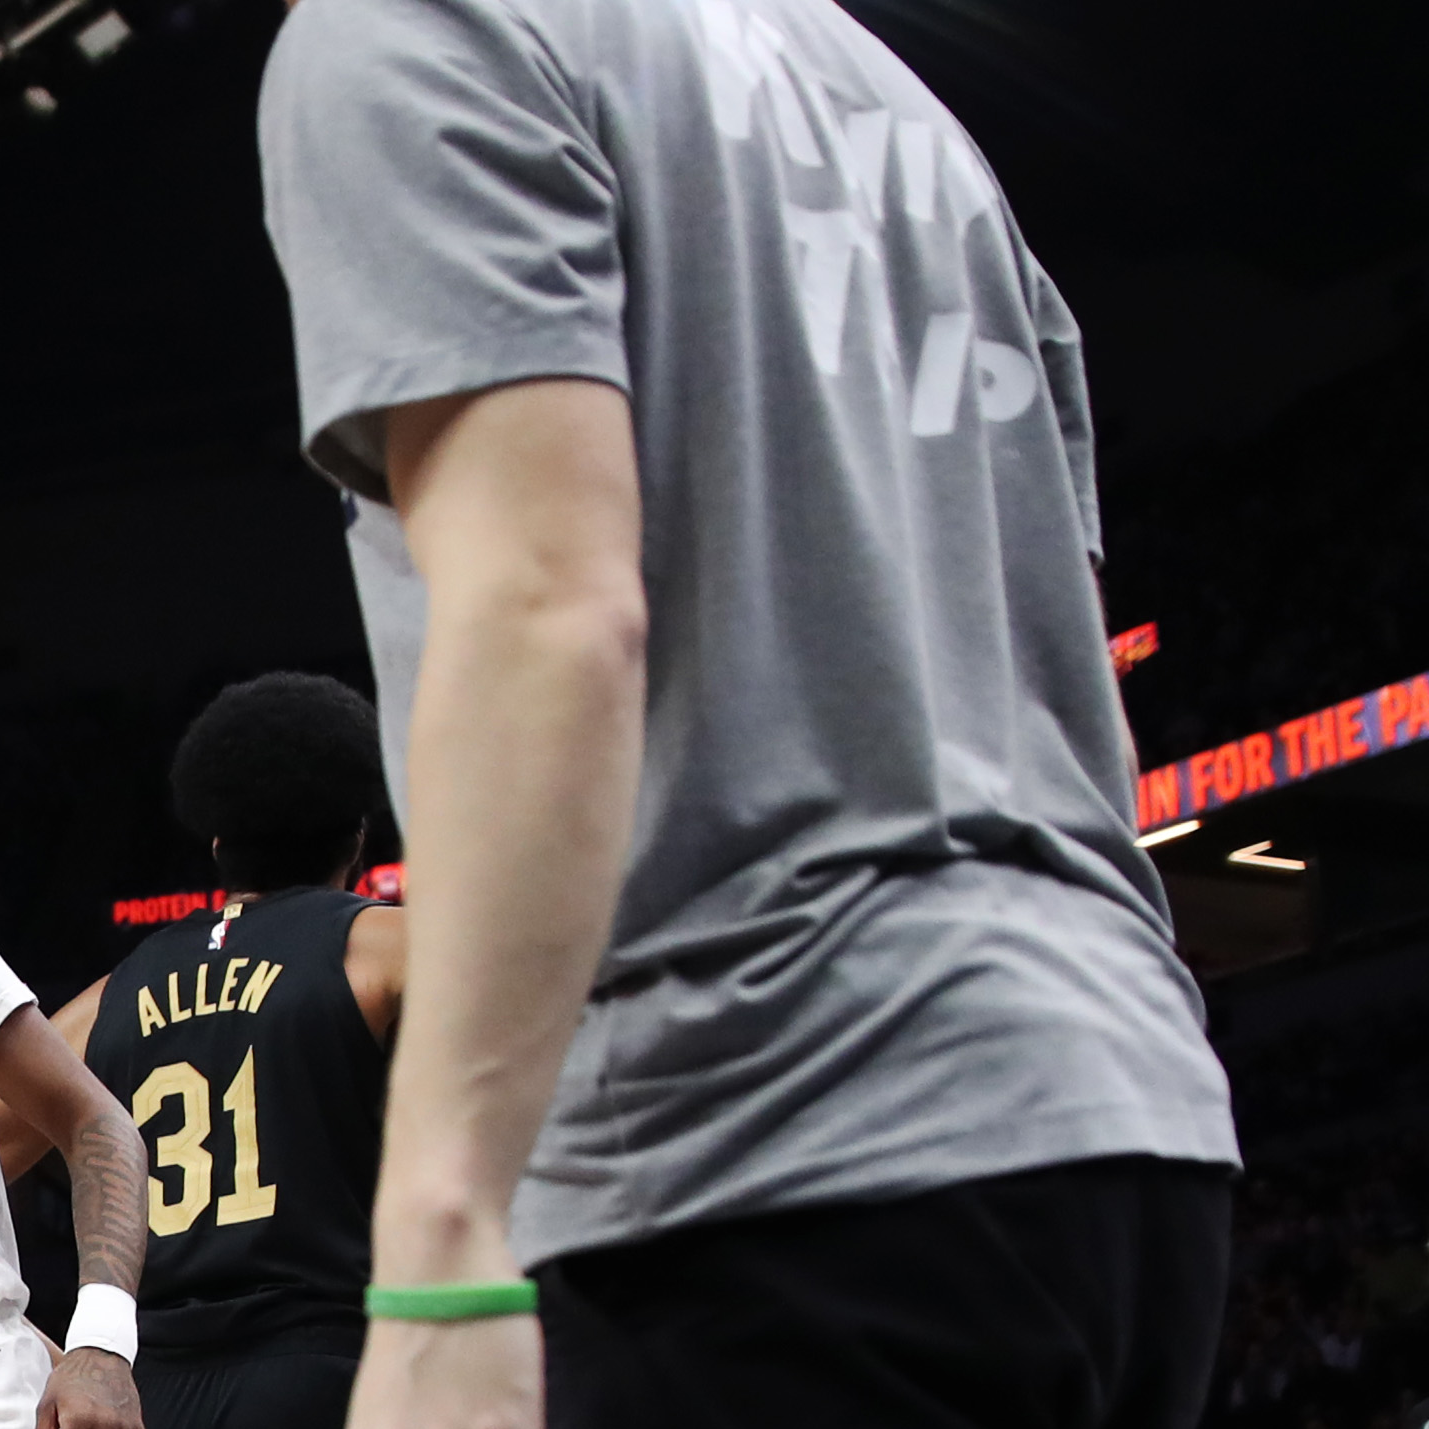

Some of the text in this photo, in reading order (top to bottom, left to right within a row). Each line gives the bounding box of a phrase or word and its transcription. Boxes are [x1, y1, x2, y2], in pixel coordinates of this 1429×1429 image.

[1189, 732, 1276, 812] FOR
[1278, 698, 1369, 778] THE
[138, 957, 283, 1037] ALLEN
[132, 1044, 277, 1237] 31
